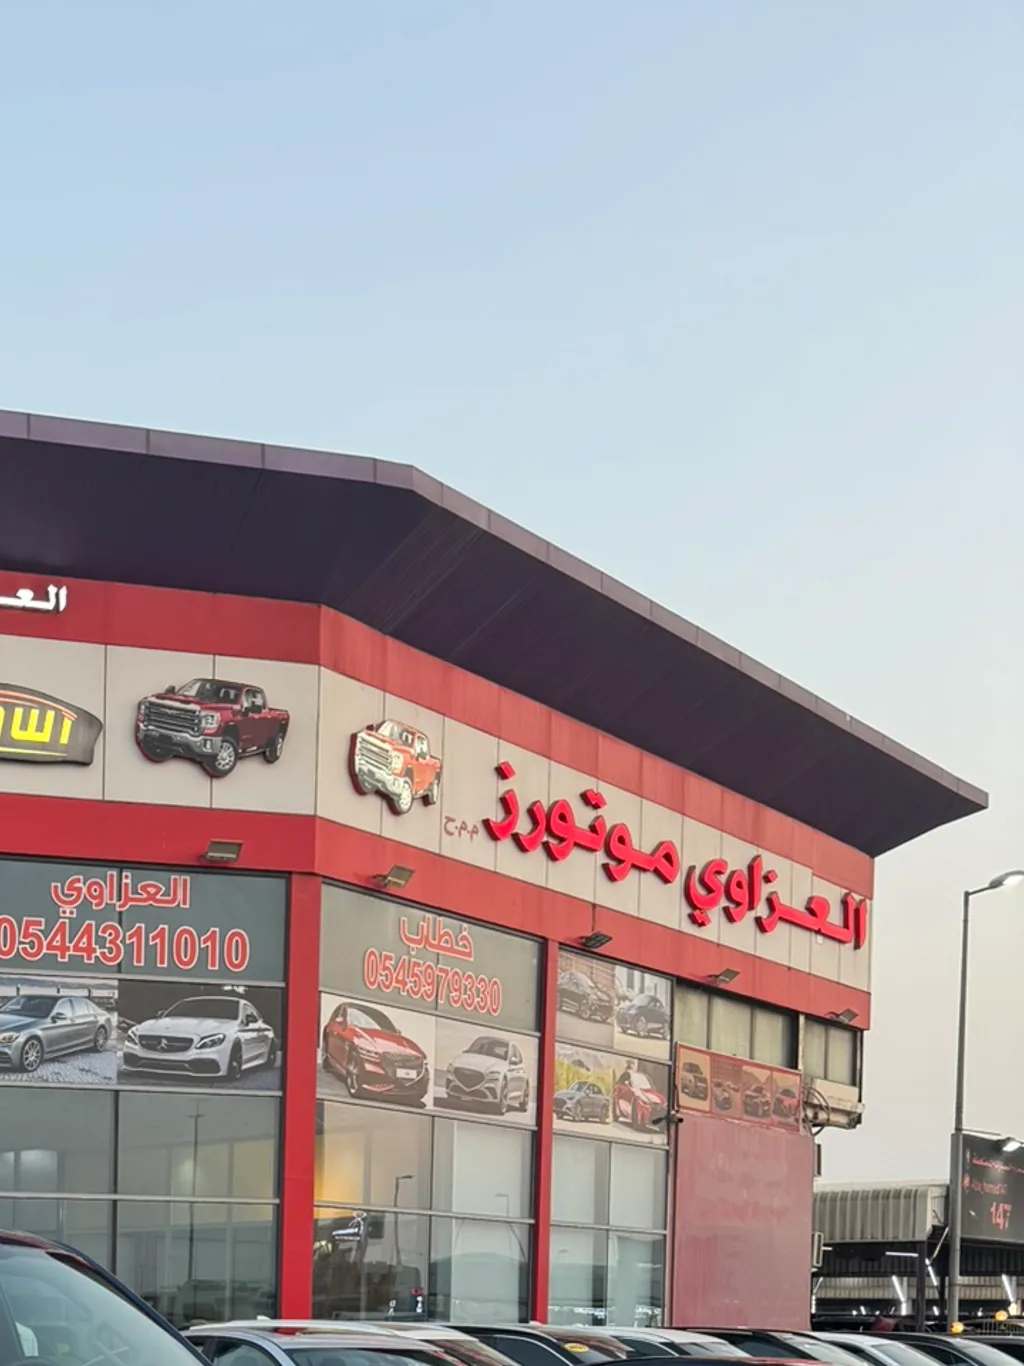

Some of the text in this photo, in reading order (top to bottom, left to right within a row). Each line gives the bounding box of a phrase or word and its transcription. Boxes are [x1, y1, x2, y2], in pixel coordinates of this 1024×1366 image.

[482, 761, 681, 884] موتورز
[50, 871, 191, 917] العزاوي
[684, 854, 868, 951] العزاوي
[399, 914, 474, 961] خطاب
[364, 947, 503, 1017] 0545979330
